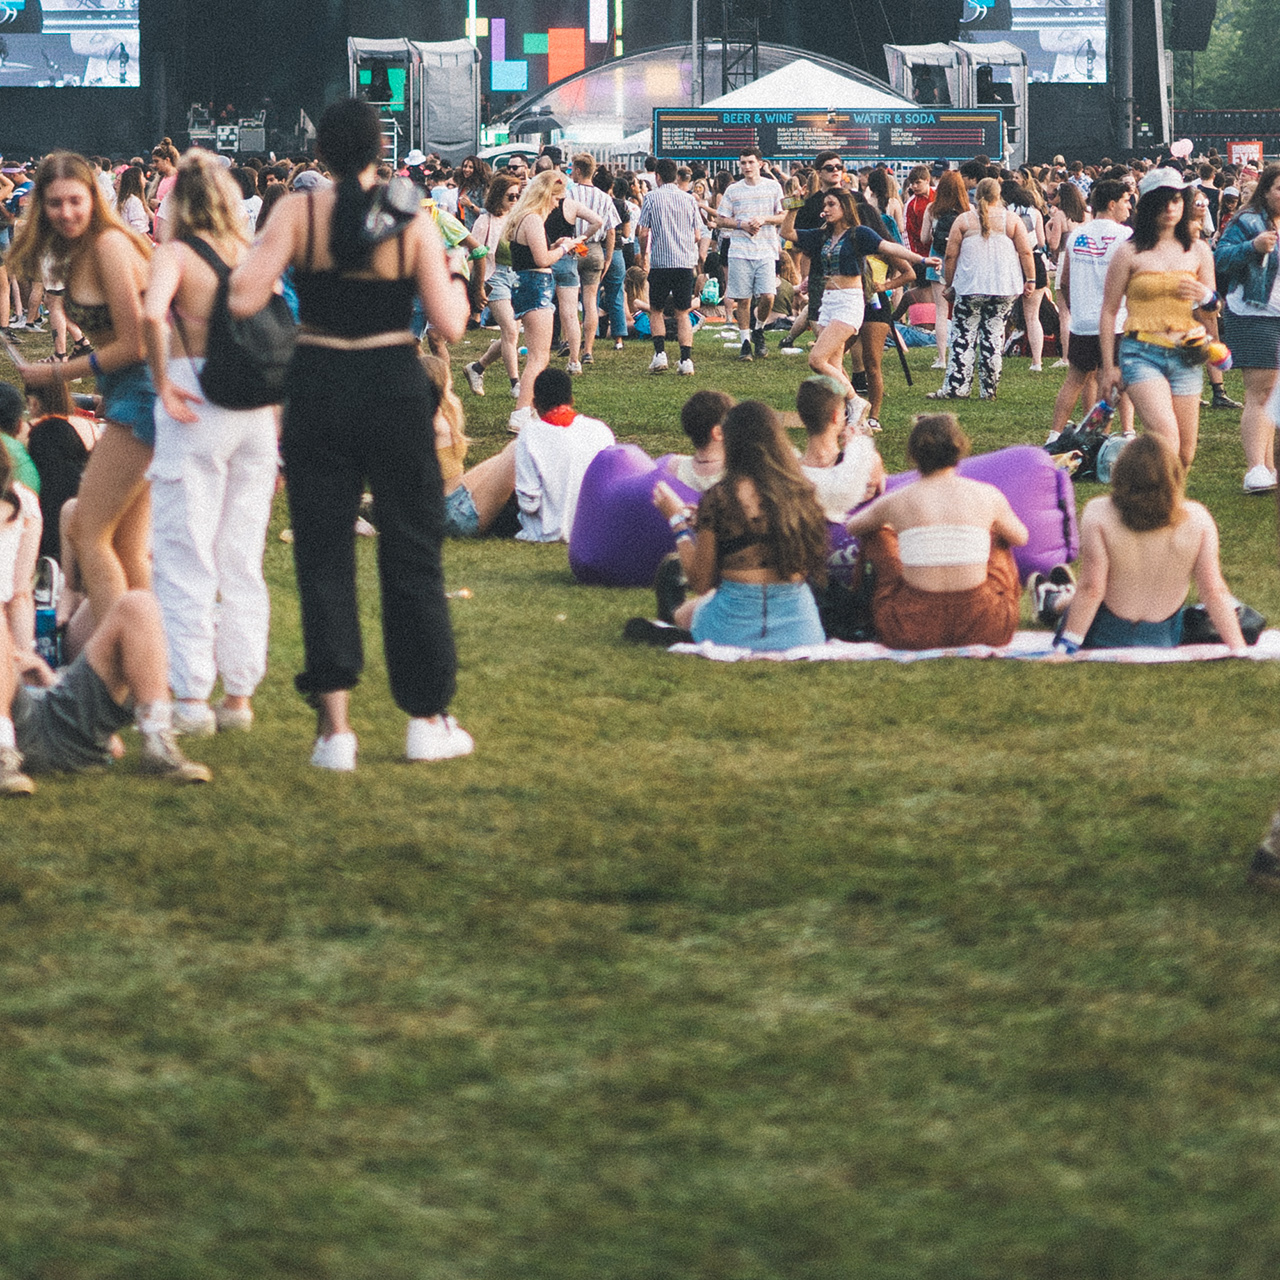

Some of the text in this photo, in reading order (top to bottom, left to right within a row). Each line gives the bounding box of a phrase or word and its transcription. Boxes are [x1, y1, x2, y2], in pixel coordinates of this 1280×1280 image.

[722, 113, 794, 124] BEER & WINE
[853, 113, 936, 124] WATER & SODA
